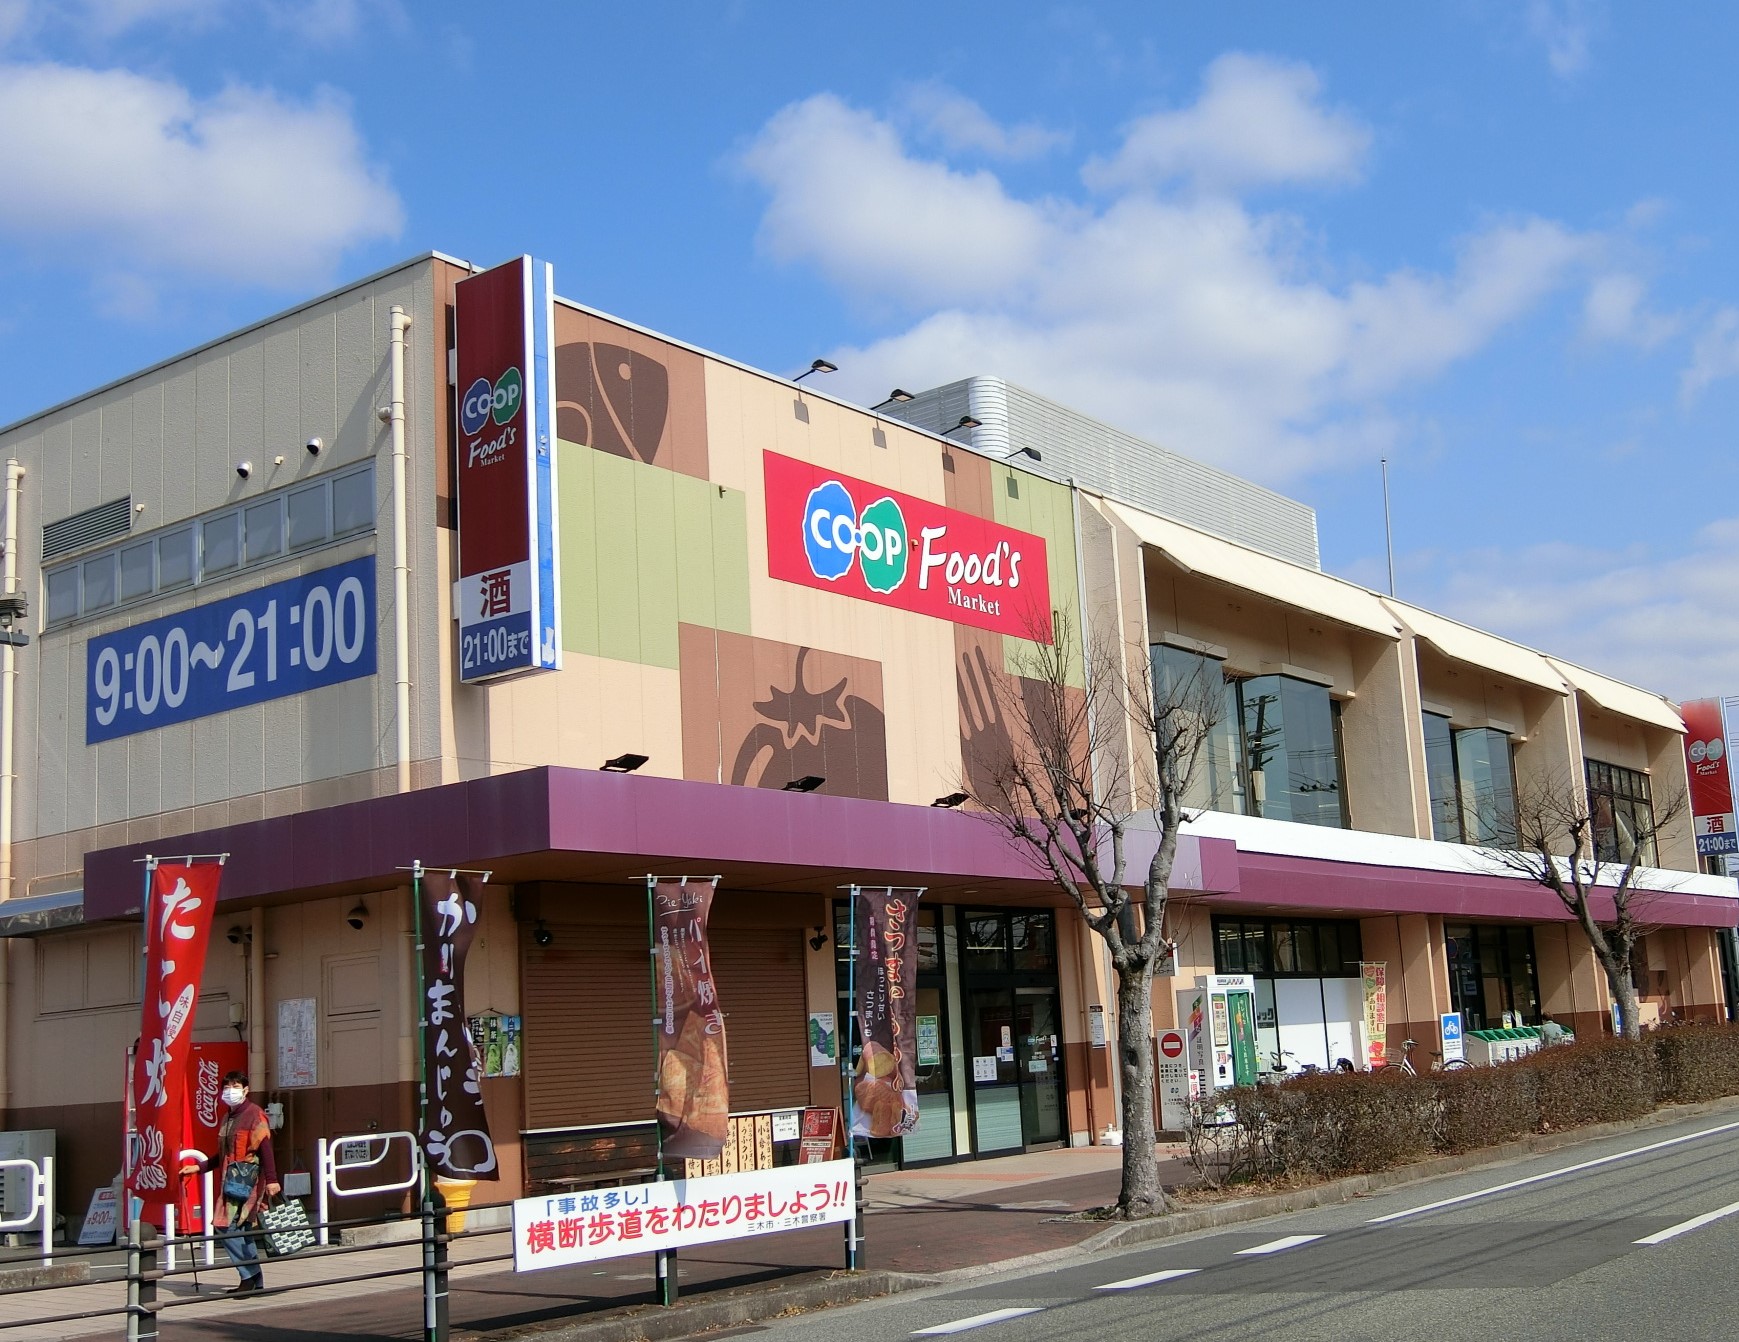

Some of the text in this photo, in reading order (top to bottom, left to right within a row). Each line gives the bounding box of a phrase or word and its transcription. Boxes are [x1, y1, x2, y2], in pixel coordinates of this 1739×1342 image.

[468, 426, 517, 468] Food's
[480, 453, 505, 467] Market
[918, 525, 1022, 590] Food's
[480, 568, 512, 618] 酒
[947, 586, 1001, 616] Market
[463, 626, 529, 669] 21:00まで
[1706, 815, 1725, 834] 酒
[1699, 836, 1737, 853] 21:00まで
[863, 990, 875, 1037] さつまいも
[526, 1180, 848, 1255] 横断歩道をわたりましょう!!
[546, 1187, 650, 1217] 「事故多し」
[747, 1212, 827, 1233] 三木市・三木警察署
